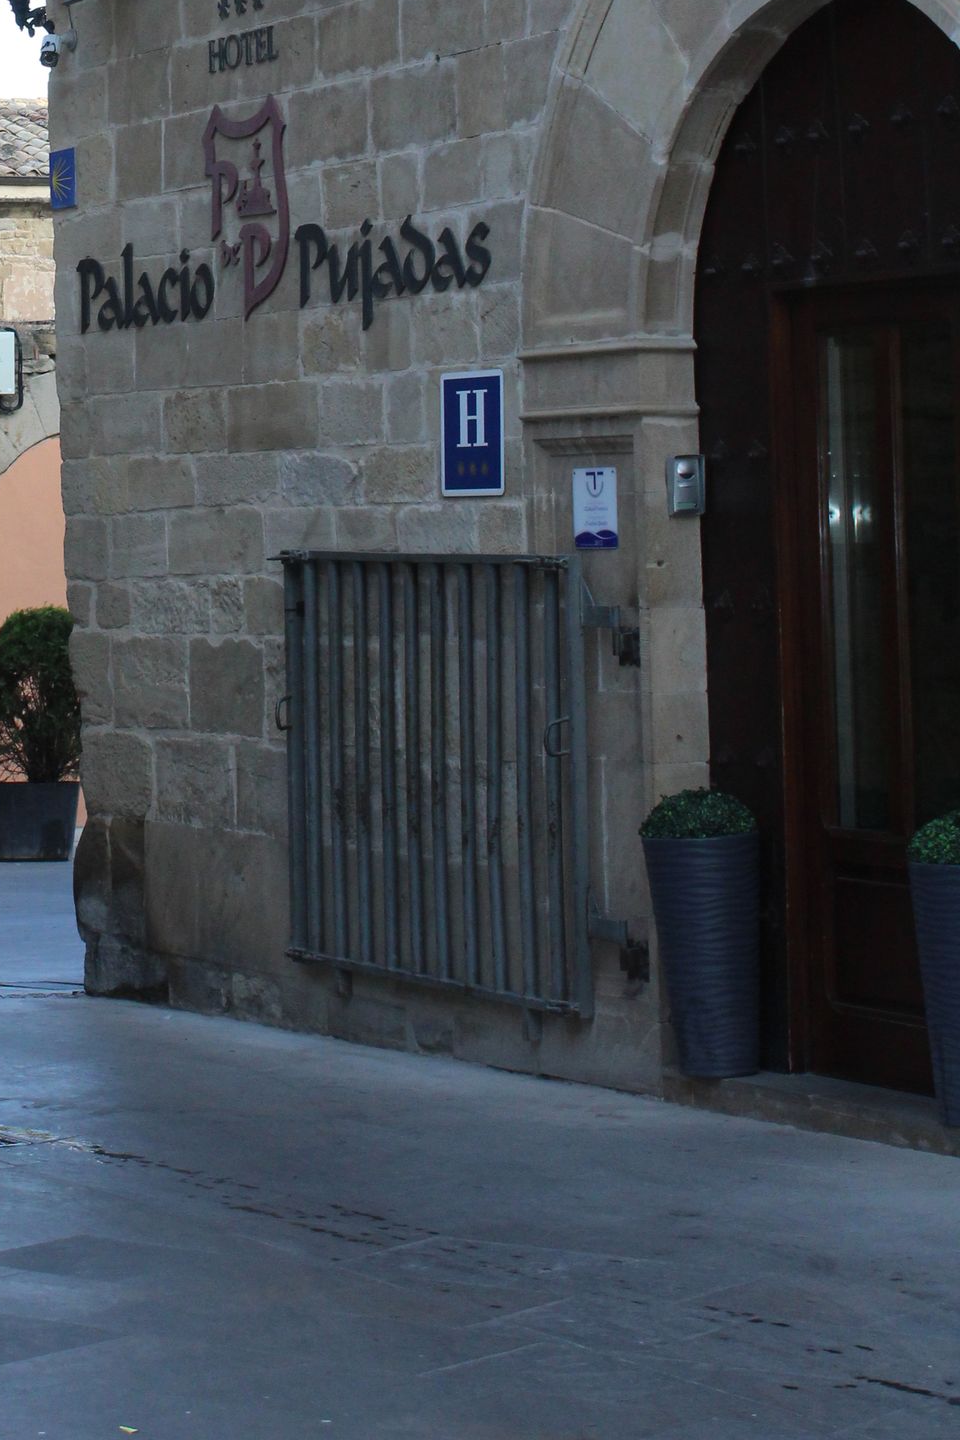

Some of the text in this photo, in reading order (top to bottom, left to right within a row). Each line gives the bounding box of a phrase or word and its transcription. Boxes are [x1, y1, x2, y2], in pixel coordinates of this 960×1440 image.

[208, 26, 279, 73] HOTEL
[76, 242, 215, 335] Palacio
[295, 214, 492, 330] Pujadas
[456, 389, 488, 448] H
